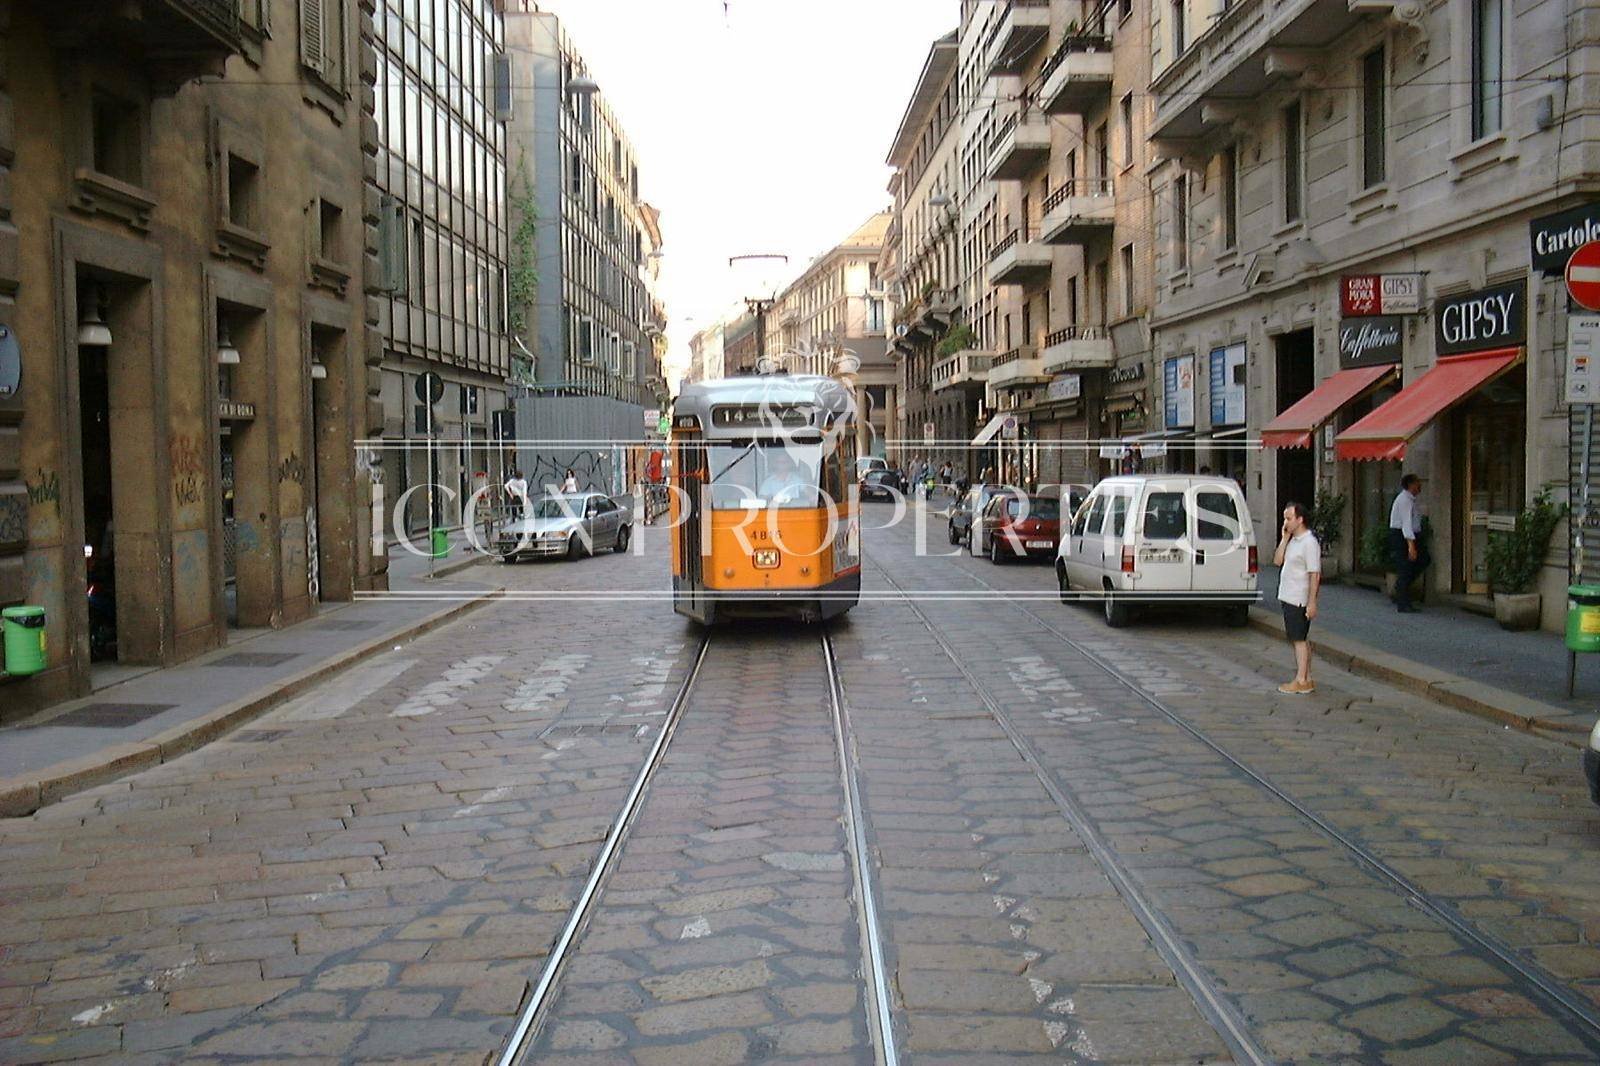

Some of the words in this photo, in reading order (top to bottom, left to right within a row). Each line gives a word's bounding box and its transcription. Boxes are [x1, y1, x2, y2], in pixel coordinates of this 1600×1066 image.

[1383, 278, 1414, 295] GIPSY
[1442, 293, 1515, 344] GIPSY
[1340, 322, 1400, 358] Caffetteria
[724, 409, 744, 422] 14
